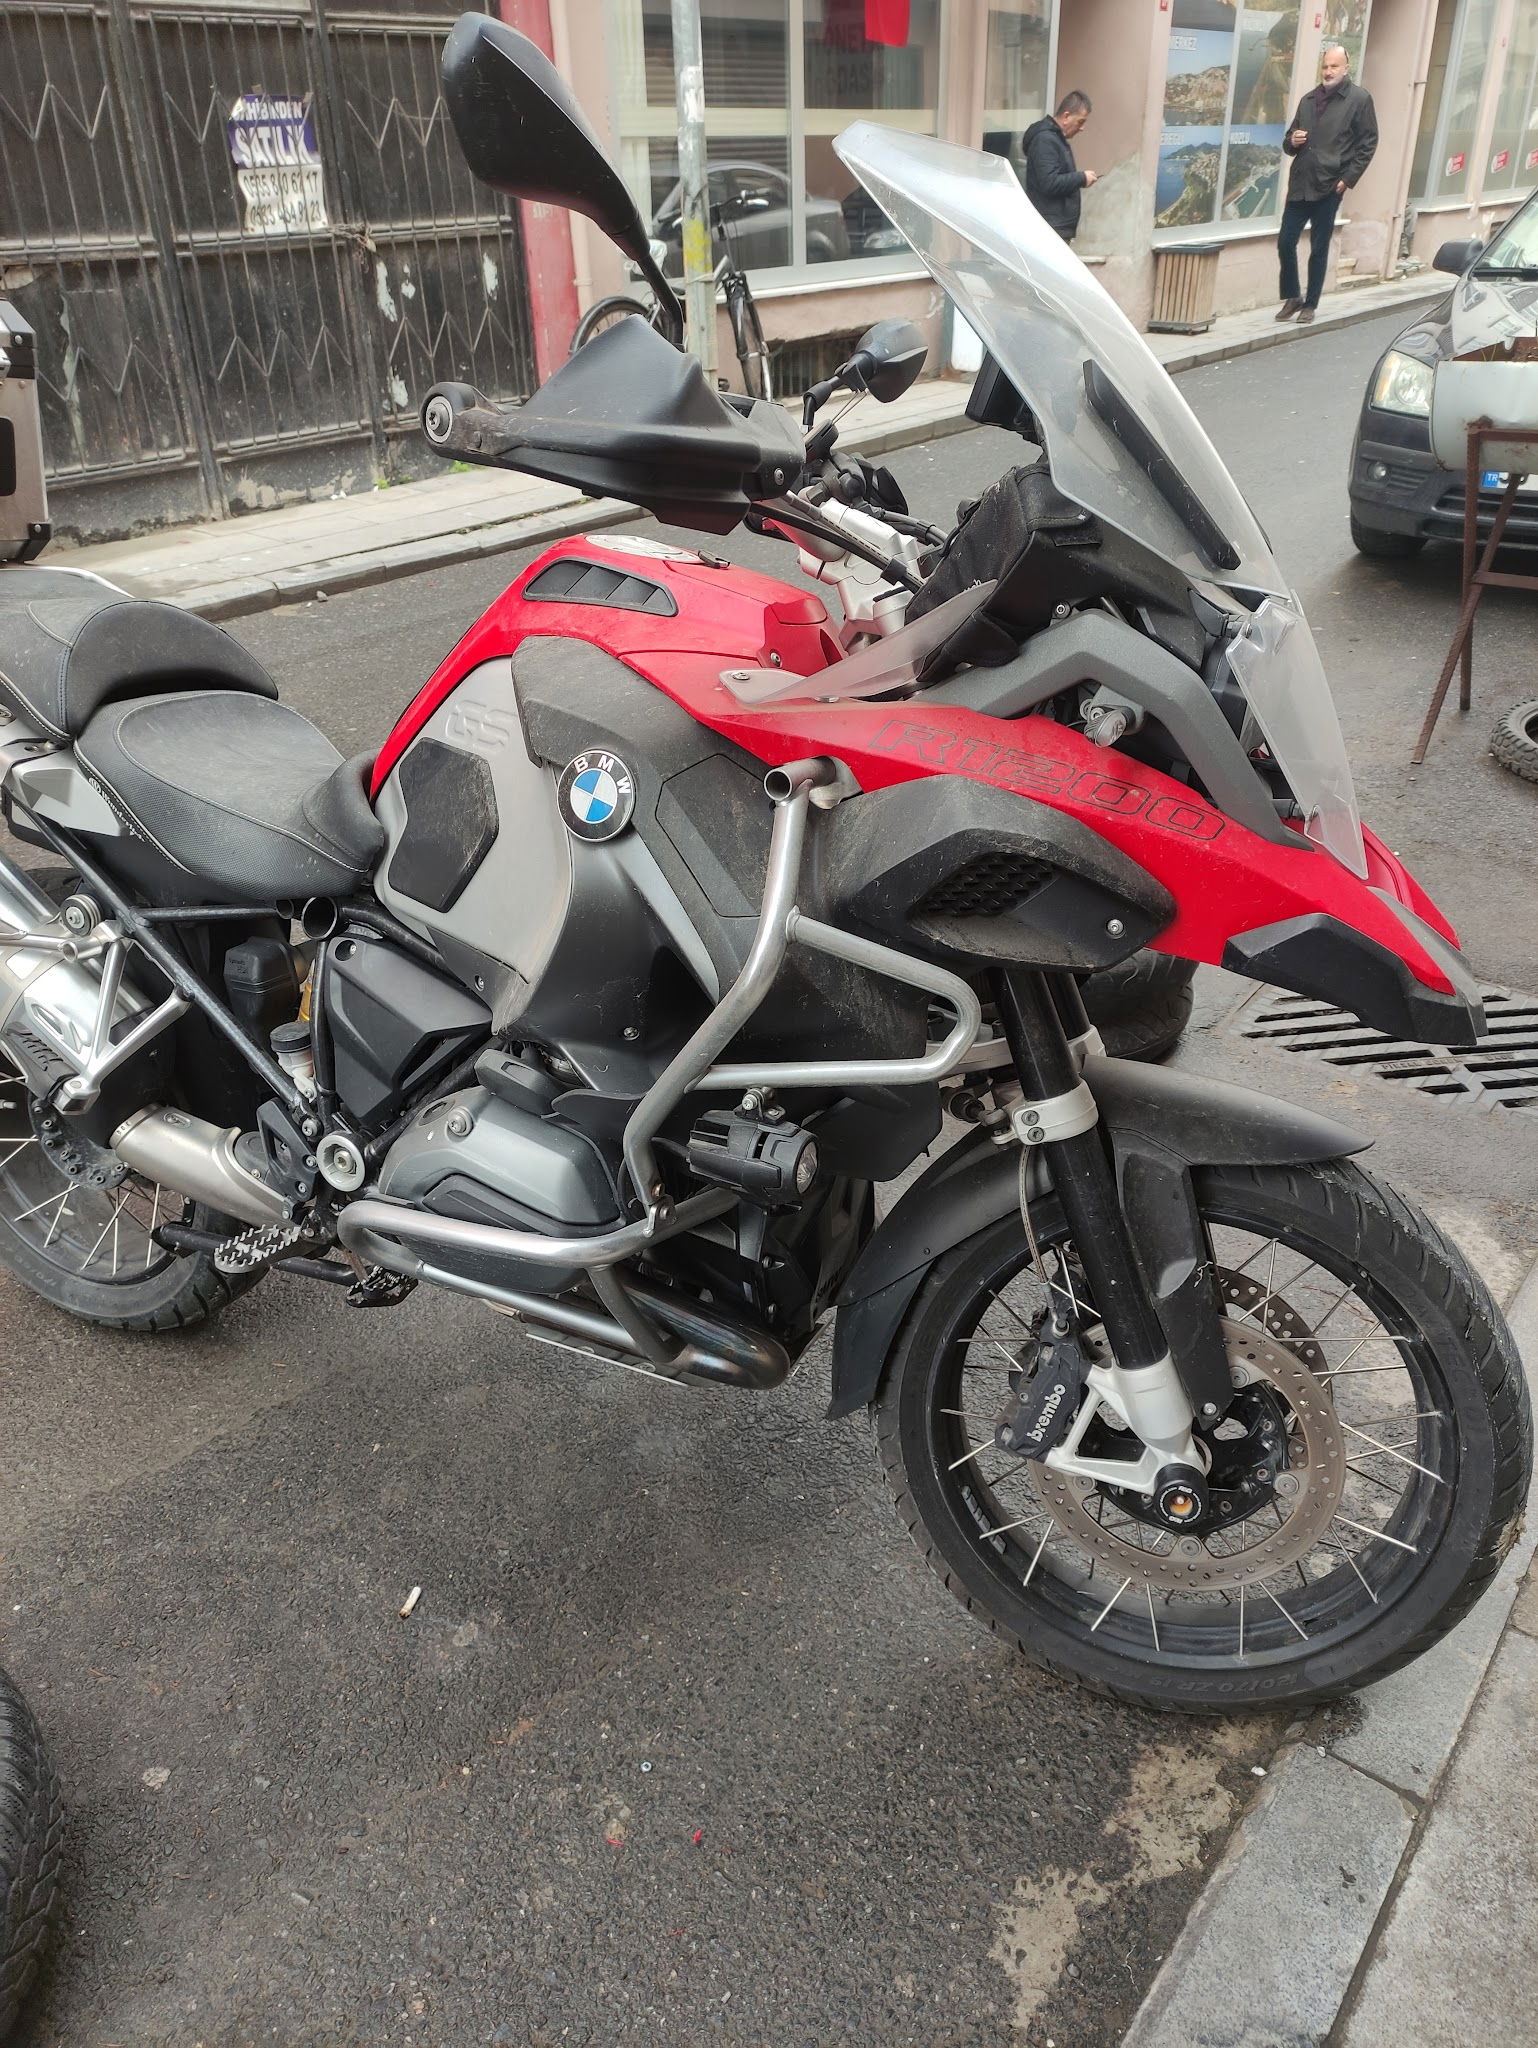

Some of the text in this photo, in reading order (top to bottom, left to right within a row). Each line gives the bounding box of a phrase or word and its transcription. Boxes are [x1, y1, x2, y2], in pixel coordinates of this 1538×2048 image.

[235, 125, 314, 168] SATILIK
[1487, 473, 1499, 482] TR
[574, 754, 631, 795] BMW
[868, 719, 1226, 841] R1200
[1026, 1384, 1066, 1442] brembo
